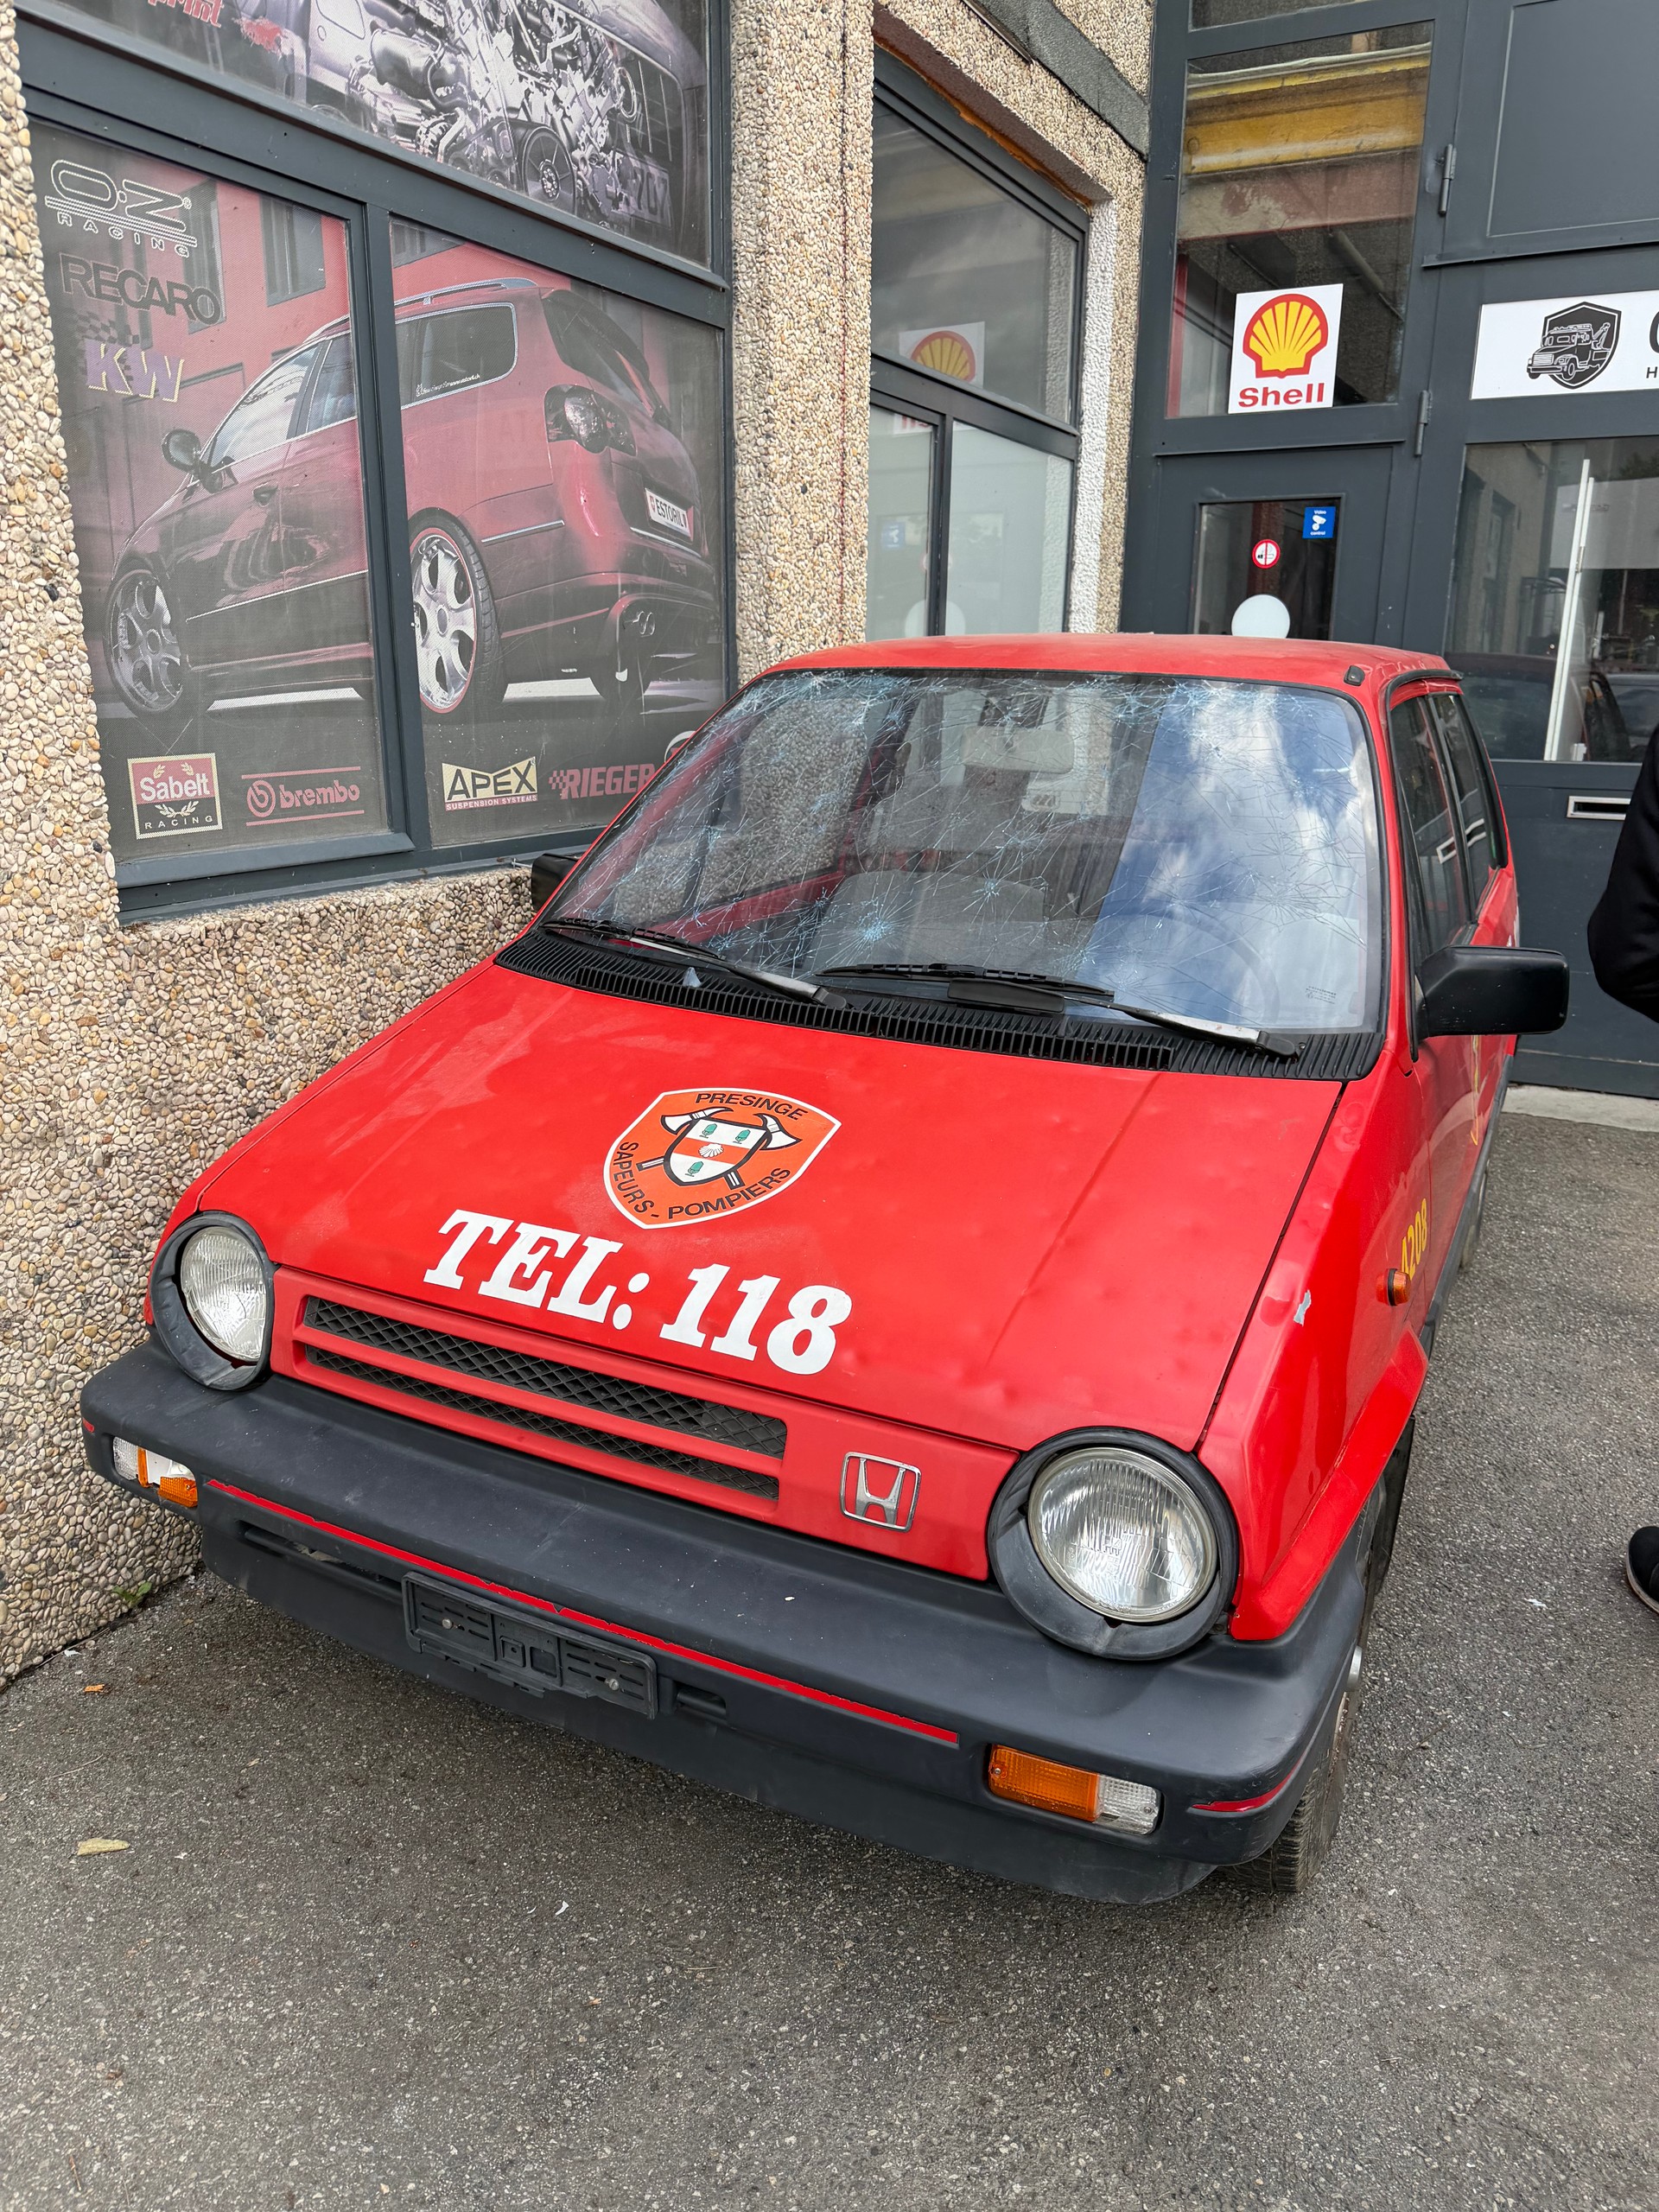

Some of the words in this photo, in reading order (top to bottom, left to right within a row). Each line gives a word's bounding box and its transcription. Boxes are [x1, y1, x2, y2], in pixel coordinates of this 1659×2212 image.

[57, 211, 189, 258] RACING
[60, 252, 222, 326] RECARO
[86, 338, 185, 404] KW
[1238, 383, 1325, 408] Shell
[655, 498, 685, 528] ESTORIL
[139, 772, 210, 802] Sabelt
[279, 779, 361, 810] brembo
[447, 760, 537, 801] APEX
[446, 798, 499, 811] SUSPENSION
[501, 794, 538, 805] SYSTEMS
[144, 815, 213, 830] RACING
[695, 1092, 809, 1121] PRESINGE
[612, 1141, 656, 1214] SAPEURS
[667, 1167, 791, 1219] POMPIERS
[423, 1209, 651, 1331] TEL:
[658, 1262, 853, 1376] 118
